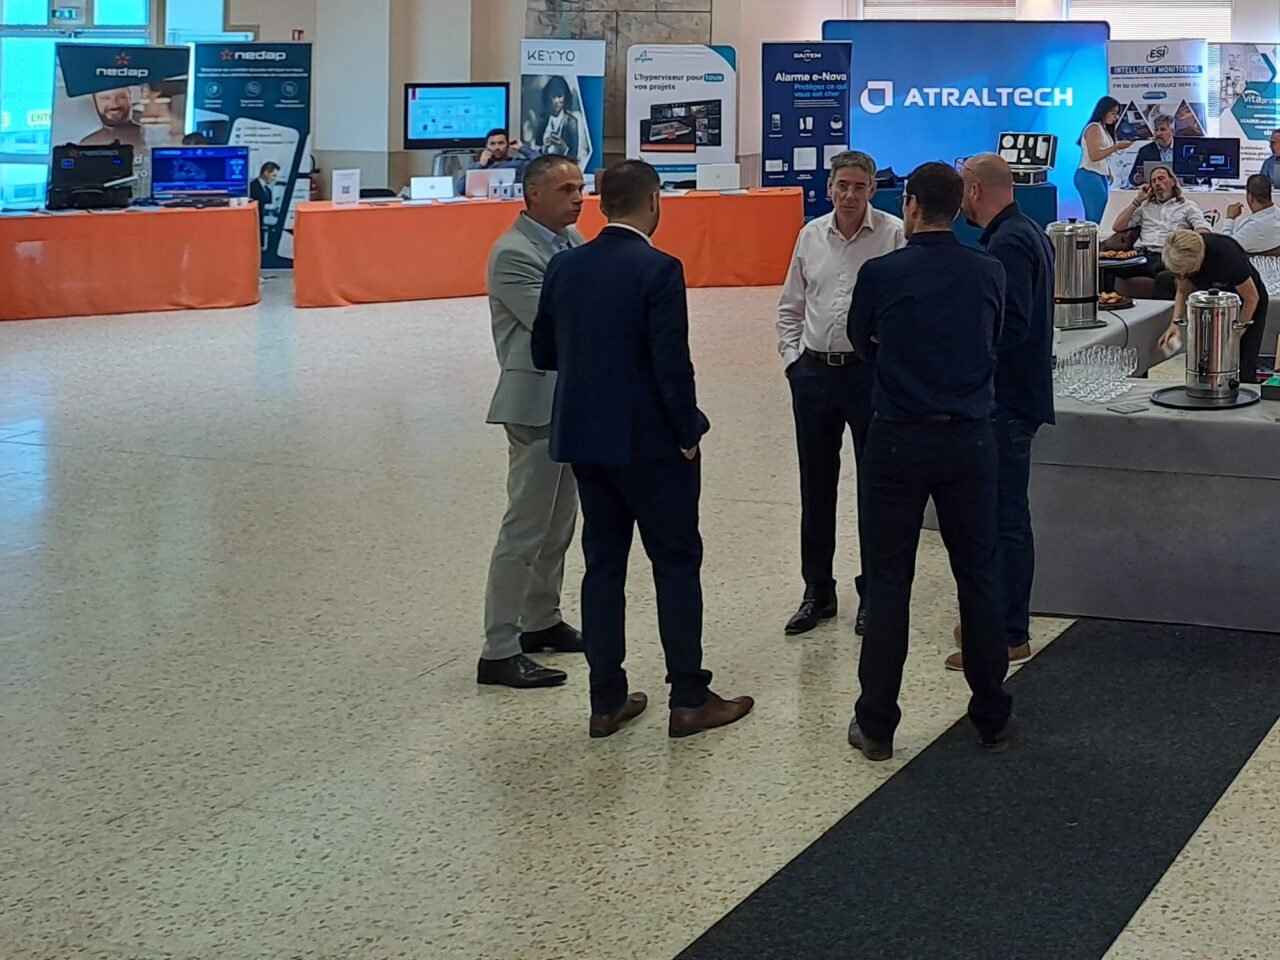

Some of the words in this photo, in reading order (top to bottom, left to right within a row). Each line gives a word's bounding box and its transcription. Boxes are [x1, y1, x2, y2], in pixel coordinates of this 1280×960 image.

[234, 50, 286, 62] nedap
[527, 49, 576, 63] KEYYO
[1150, 48, 1166, 59] ESI
[96, 67, 148, 78] nedap
[1114, 66, 1156, 74] INTELLIGENT
[1158, 65, 1199, 74] MONITORING
[634, 73, 684, 82] L'hyperviseur
[686, 74, 703, 82] pour
[775, 72, 810, 82] Alarme
[812, 72, 847, 81] e-Nova
[649, 83, 676, 91] projets
